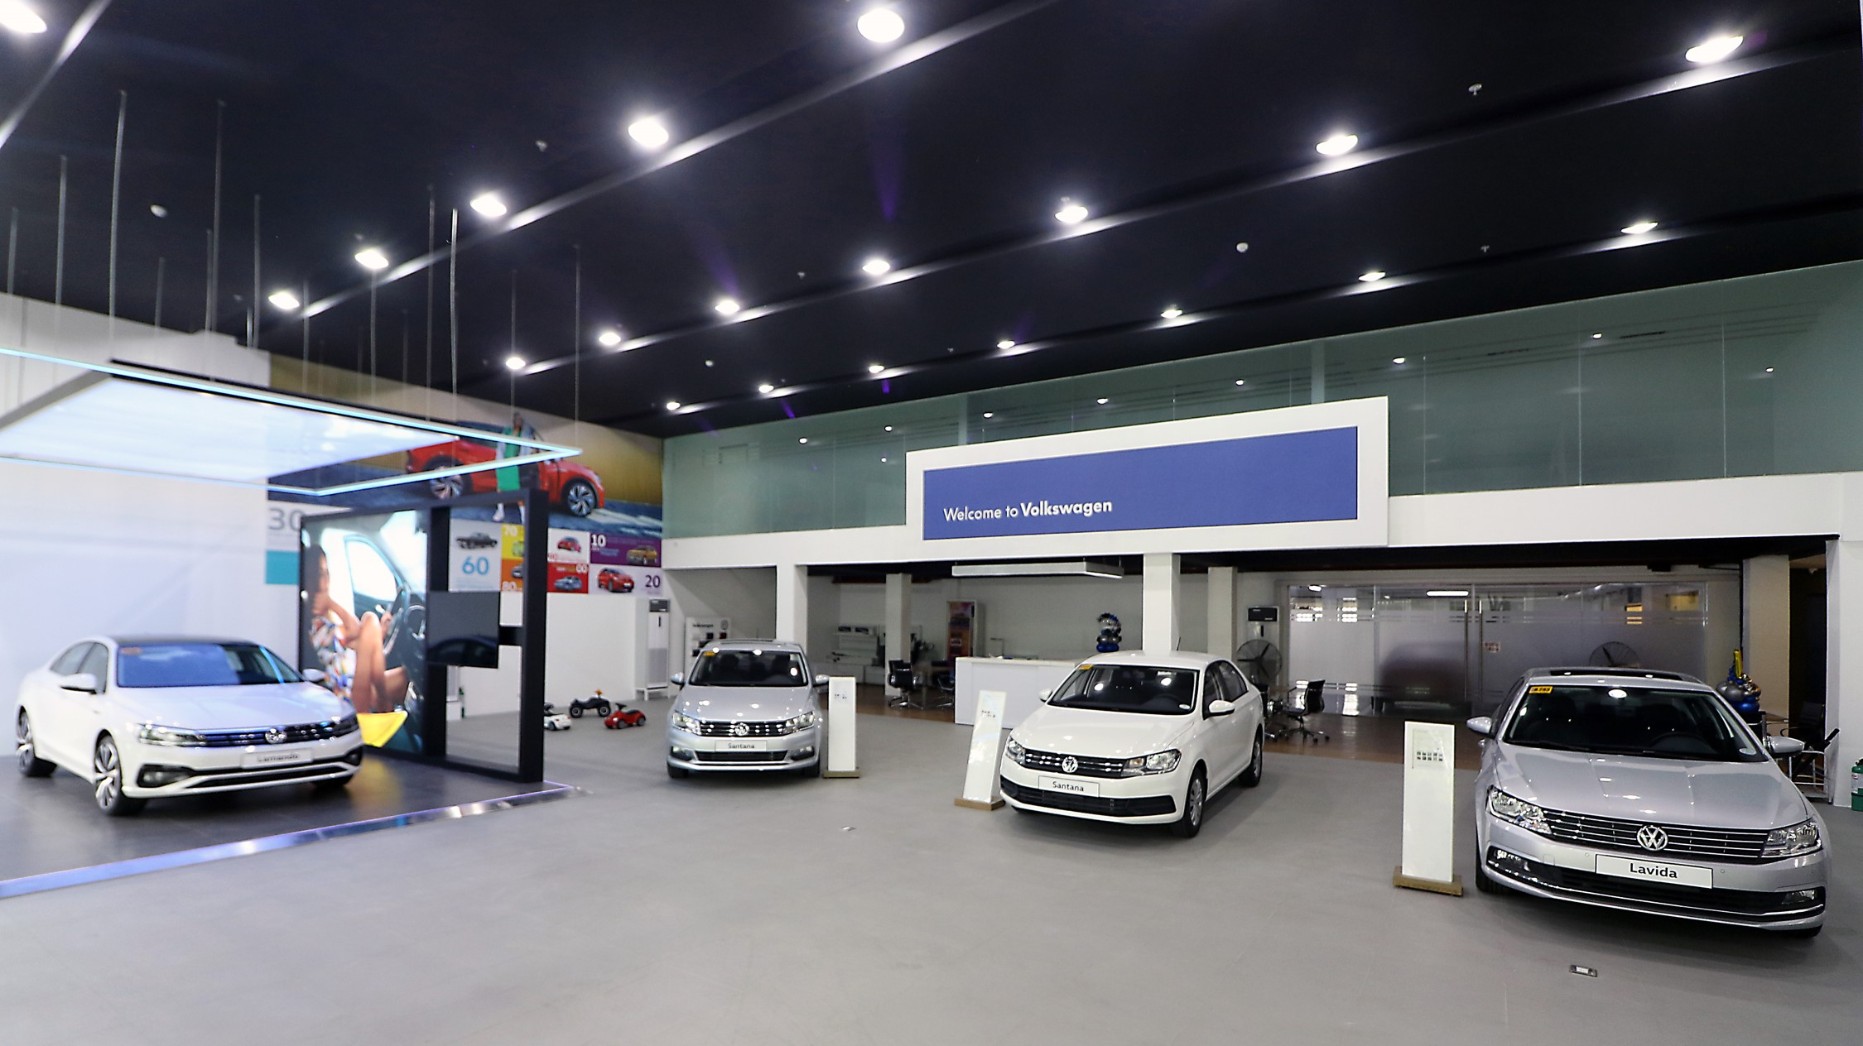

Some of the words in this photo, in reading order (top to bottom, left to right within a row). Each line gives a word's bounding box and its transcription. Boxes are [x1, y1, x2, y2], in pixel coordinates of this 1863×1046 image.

[943, 506, 1002, 521] Welcome
[1005, 505, 1018, 517] to
[1020, 500, 1113, 517] Volkswagen
[591, 534, 607, 548] 10
[462, 556, 489, 575] 60
[645, 575, 661, 588] 20
[1052, 780, 1084, 792] Santana
[1630, 863, 1678, 879] Lavida
